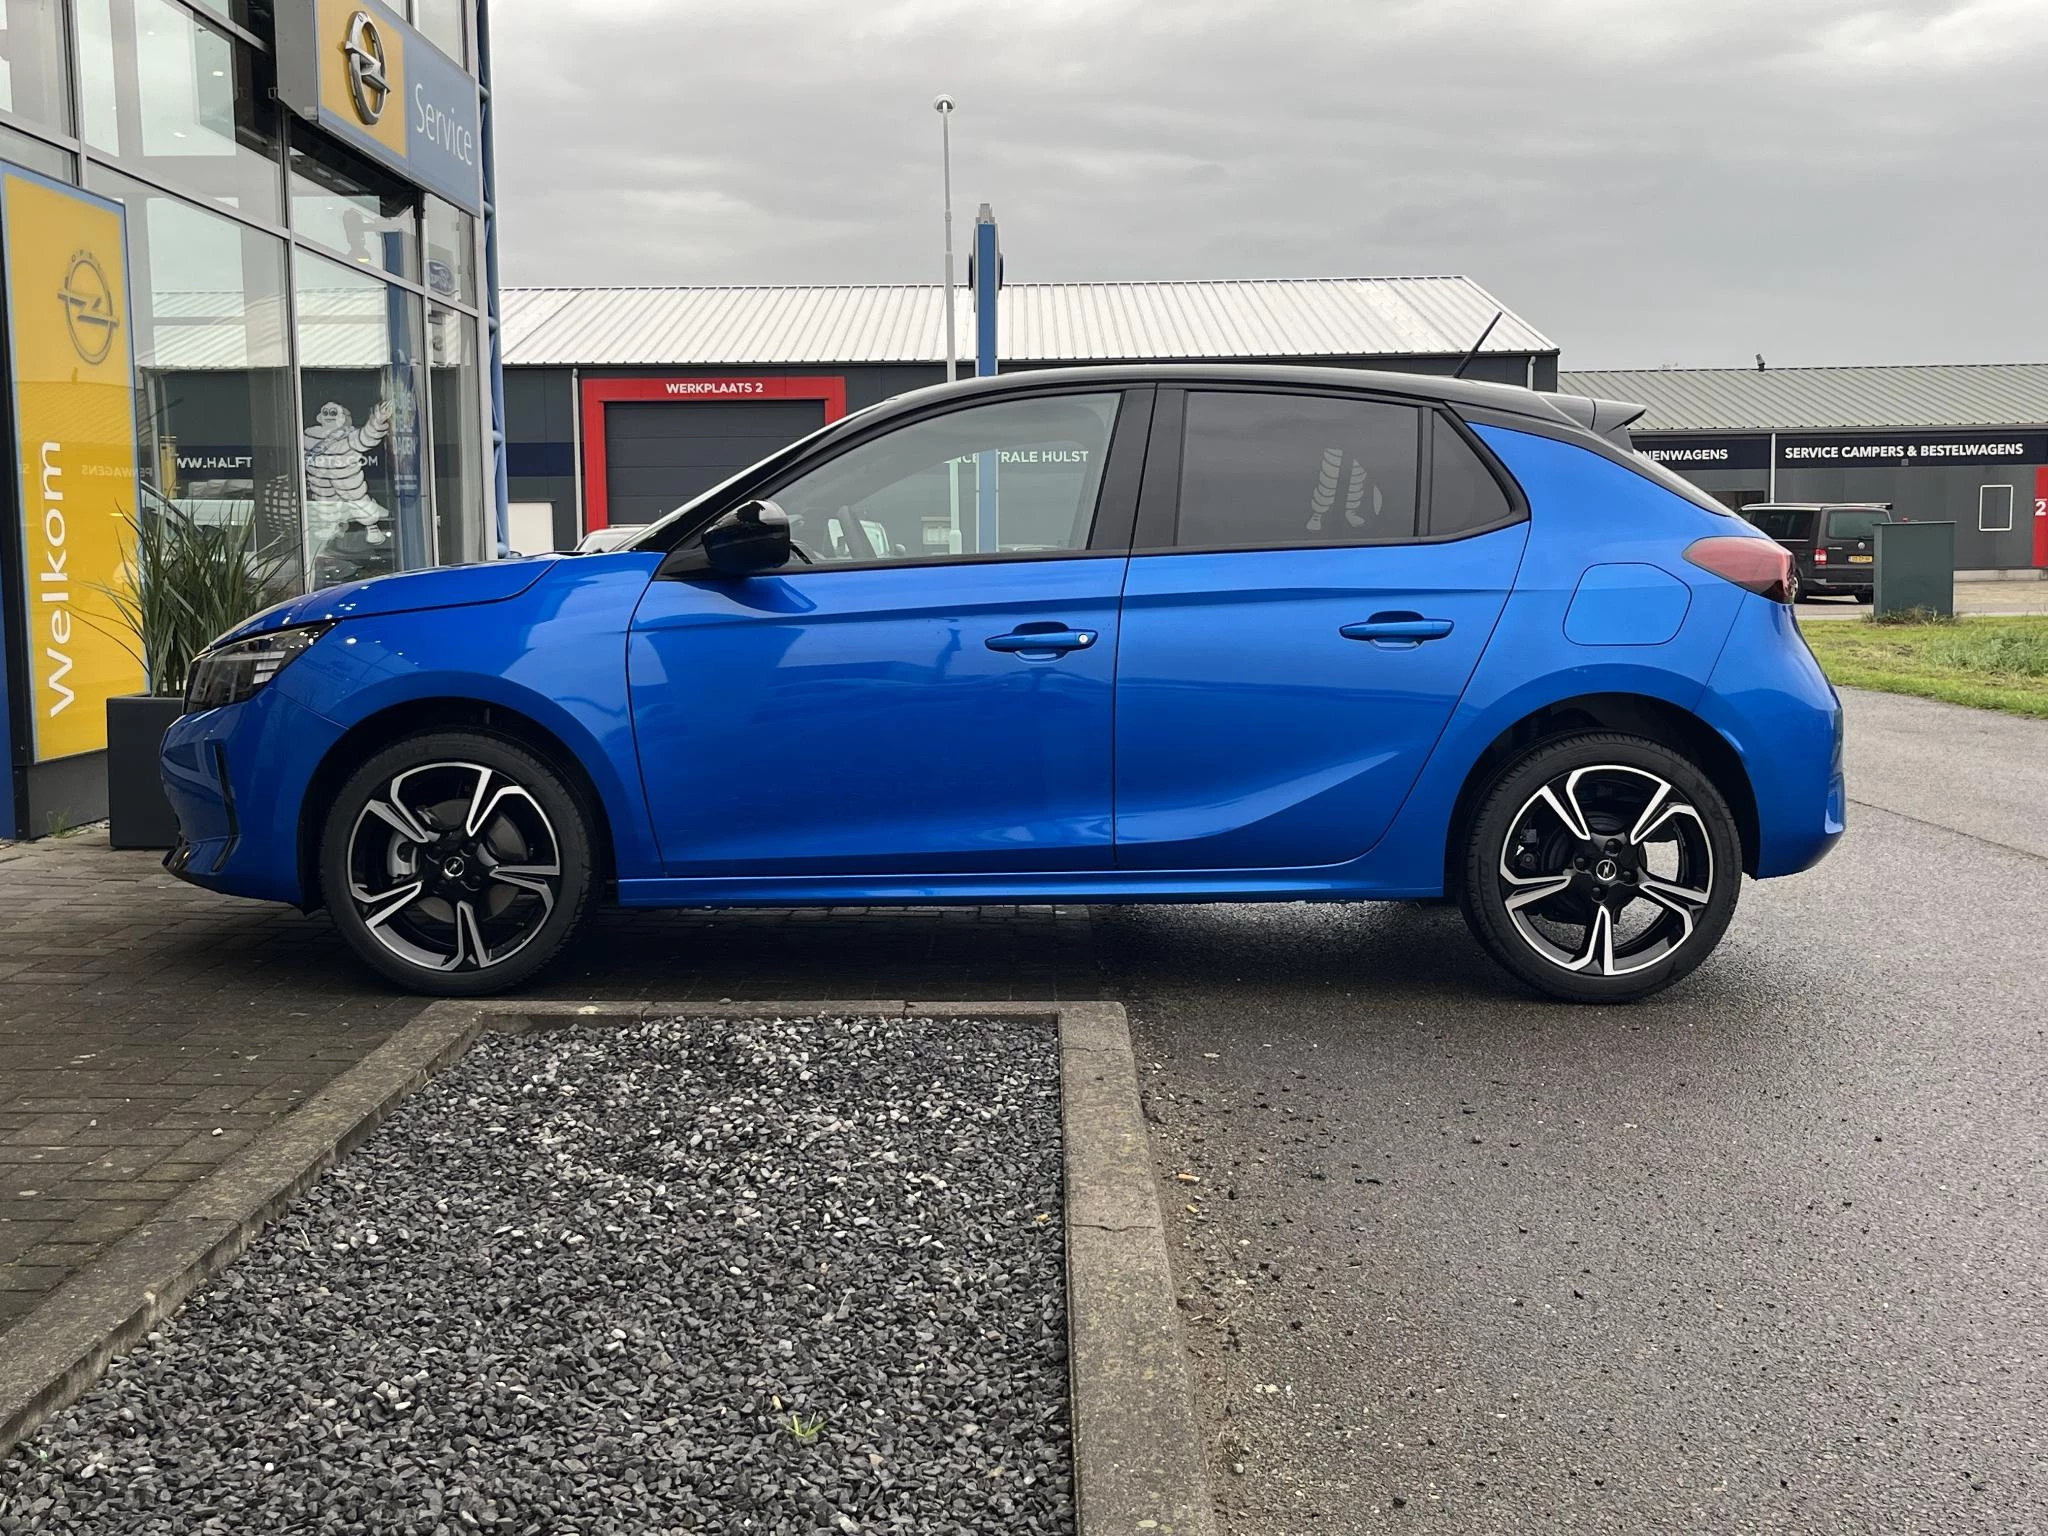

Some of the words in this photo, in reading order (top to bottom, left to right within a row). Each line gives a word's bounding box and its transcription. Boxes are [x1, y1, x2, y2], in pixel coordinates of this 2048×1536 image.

[416, 83, 472, 166] Service
[666, 383, 752, 393] WERKPLAATS
[755, 383, 763, 392] 2
[1042, 451, 1088, 462] HULST
[1785, 447, 1838, 458] SERVICE
[1842, 446, 1904, 457] CAMPERS
[1907, 446, 1917, 456] &
[1920, 444, 2024, 456] BESTELWAGENS
[2035, 501, 2047, 516] 2
[41, 442, 75, 717] Welkom
